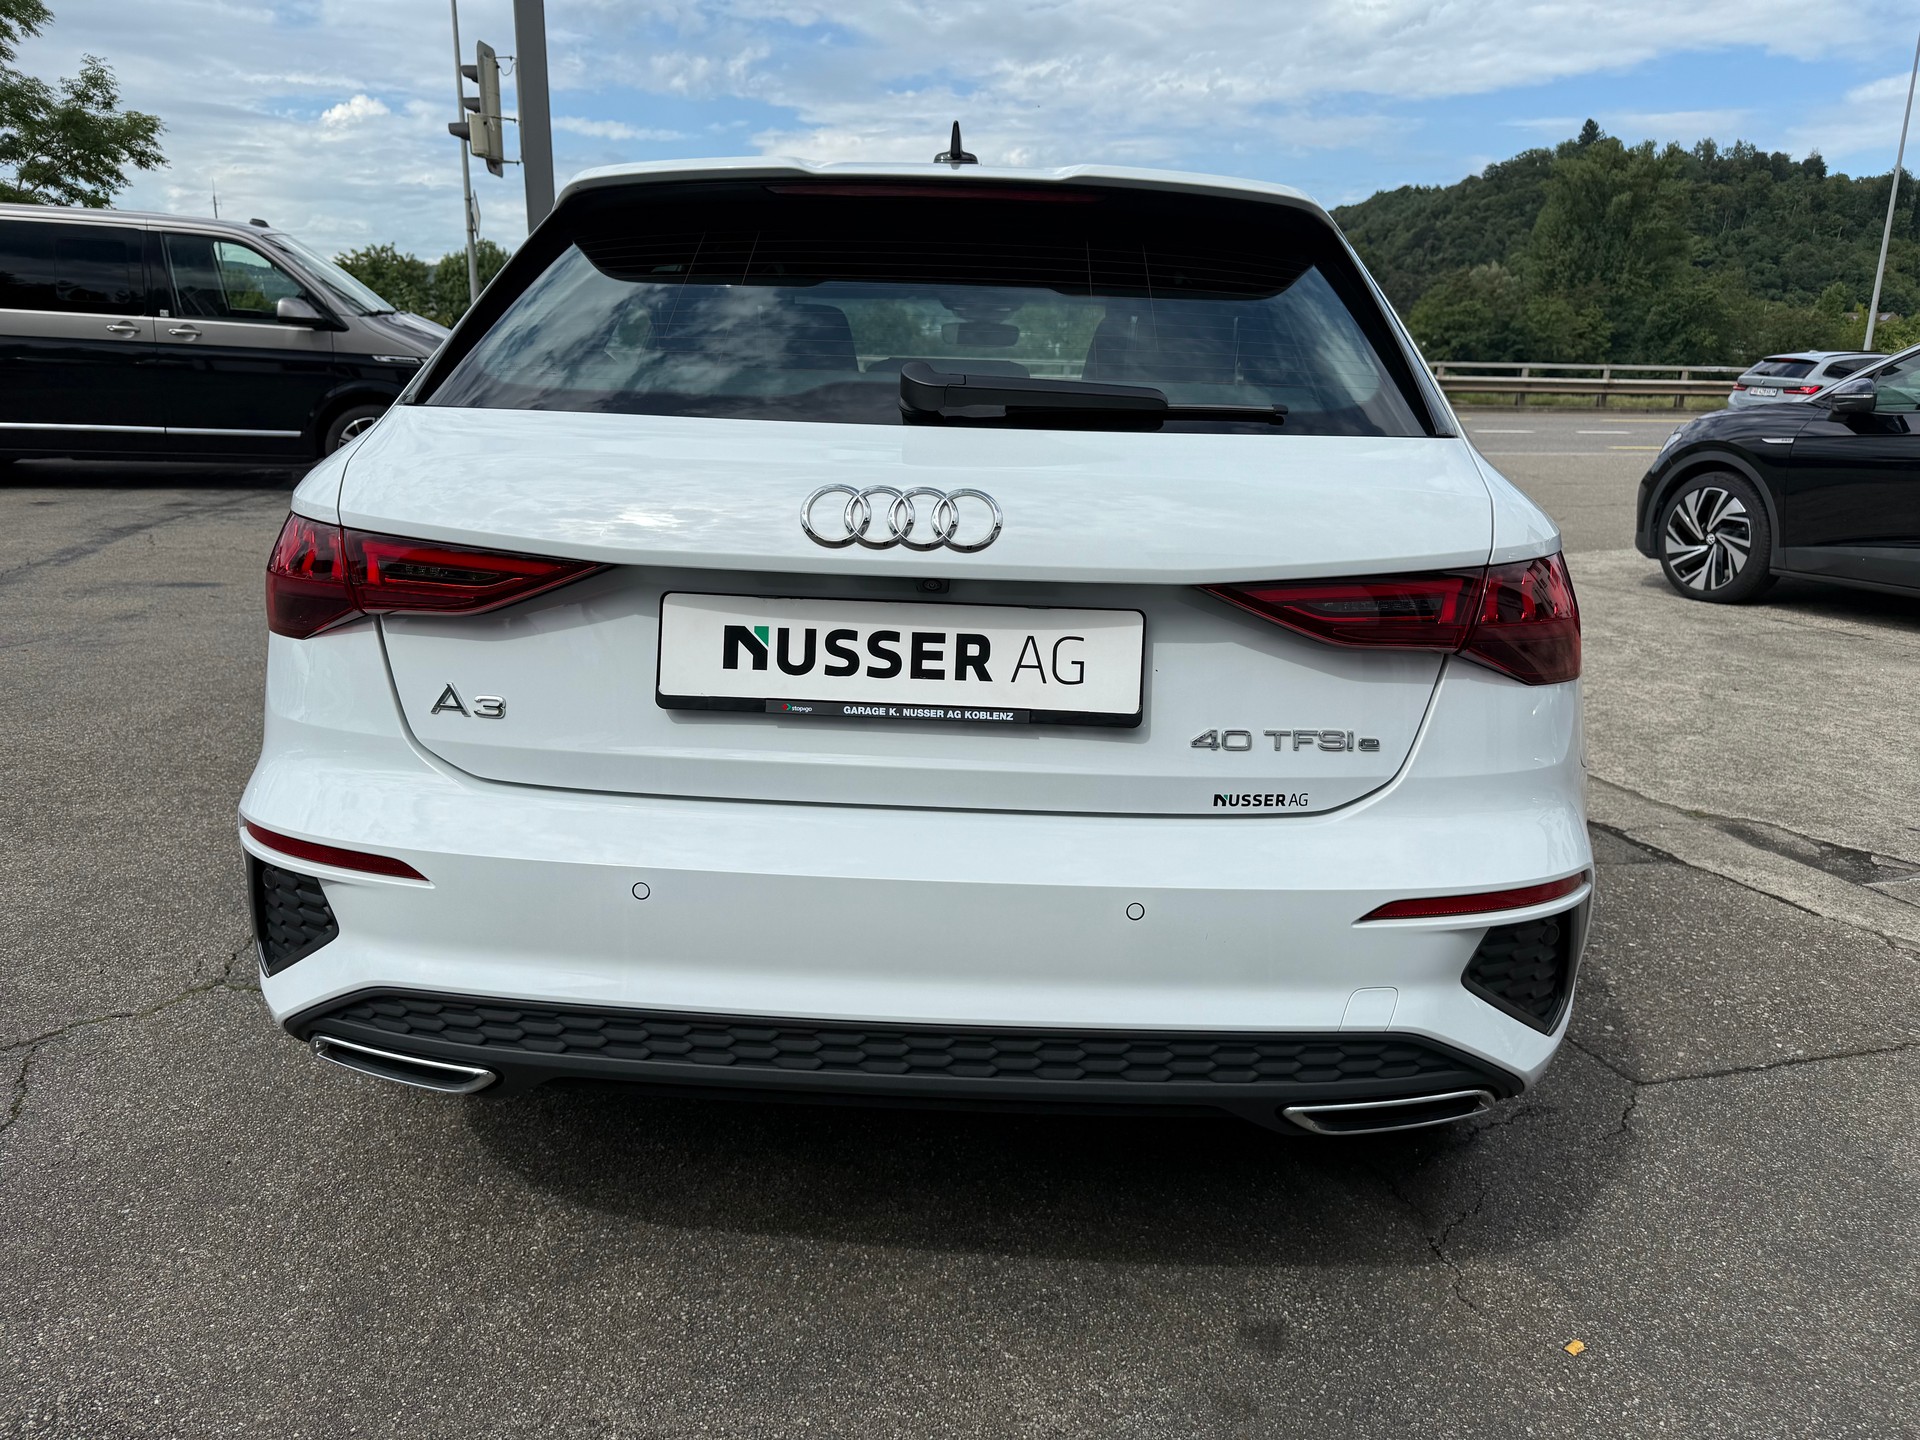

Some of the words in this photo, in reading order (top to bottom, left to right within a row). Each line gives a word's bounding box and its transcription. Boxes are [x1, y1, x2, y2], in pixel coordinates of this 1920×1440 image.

[722, 624, 993, 682] NUSSER
[1010, 635, 1085, 685] AG
[430, 682, 506, 719] A3
[843, 705, 886, 716] GARAGE
[889, 707, 900, 716] K.
[902, 708, 944, 718] NUSSER
[946, 710, 962, 719] AG
[964, 710, 1014, 720] KOBLENZ
[1190, 729, 1252, 751] 40
[1212, 793, 1286, 807] NUSSER
[1288, 793, 1309, 807] AG
